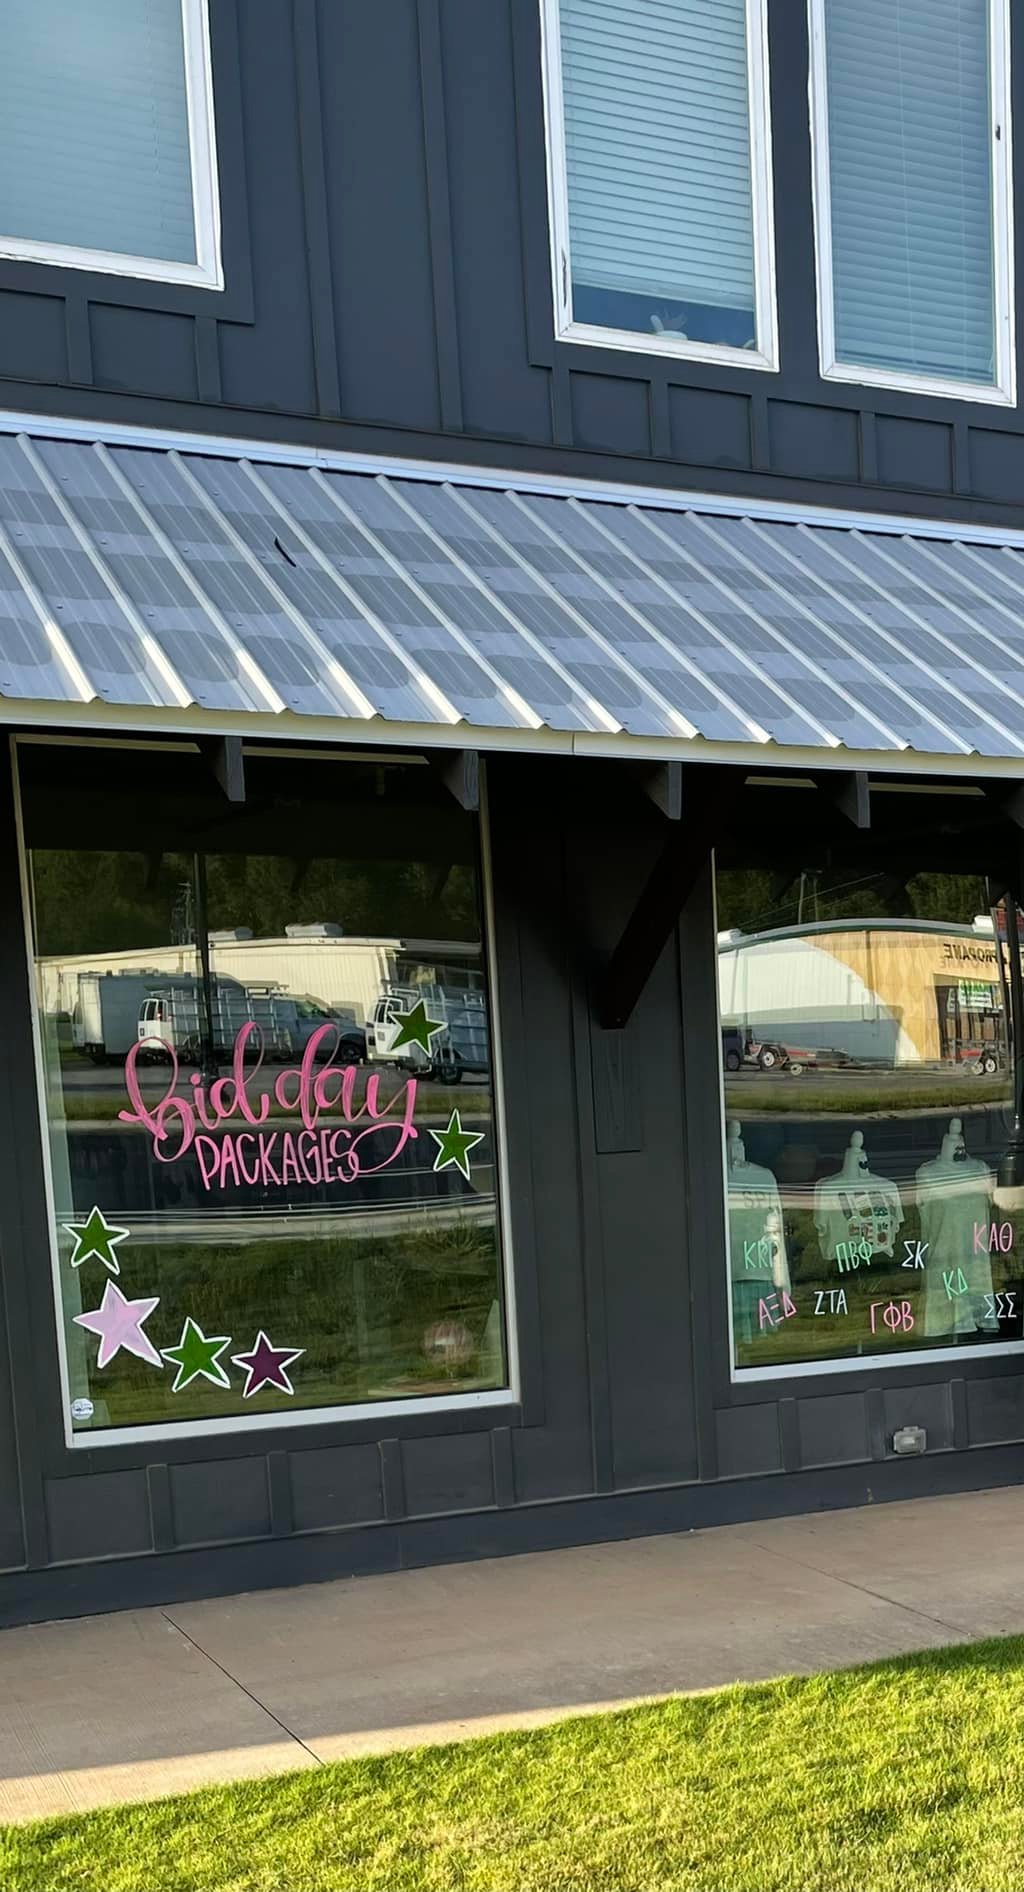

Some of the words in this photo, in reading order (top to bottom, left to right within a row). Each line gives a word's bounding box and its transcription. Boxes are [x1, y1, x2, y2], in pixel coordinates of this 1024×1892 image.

[118, 1021, 270, 1162] bid
[275, 1023, 418, 1173] day
[194, 1128, 360, 1190] PACKAGES
